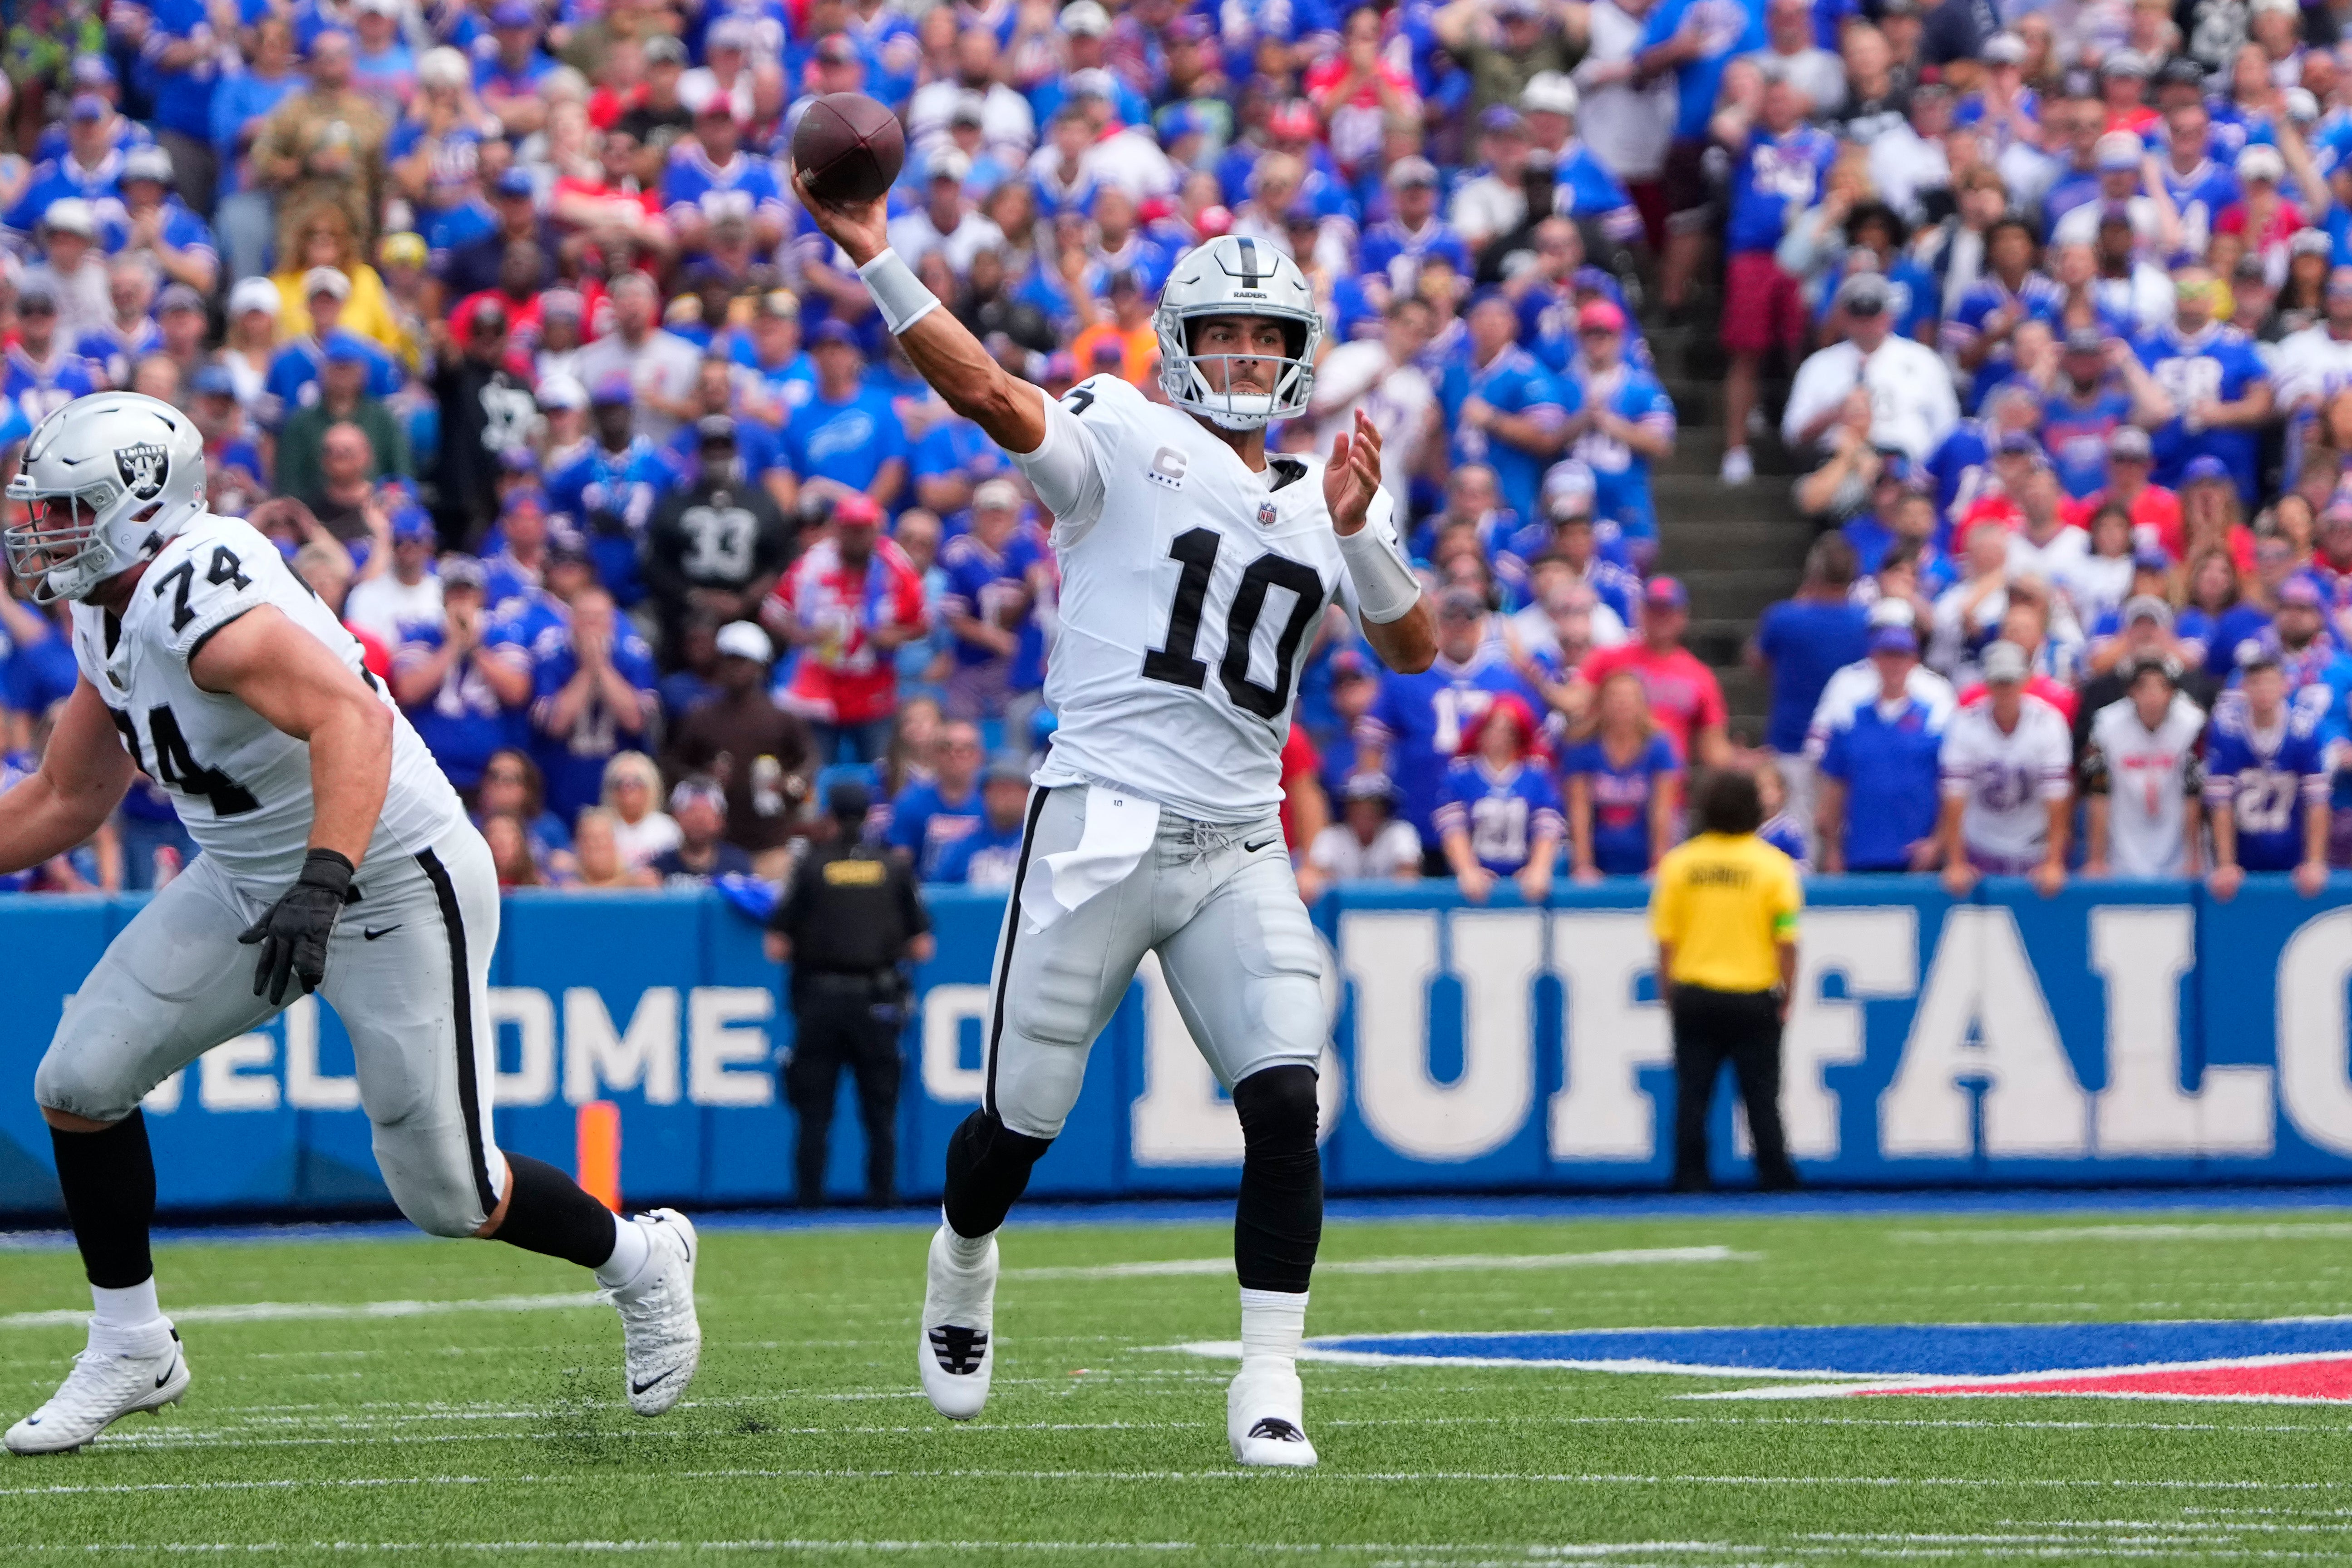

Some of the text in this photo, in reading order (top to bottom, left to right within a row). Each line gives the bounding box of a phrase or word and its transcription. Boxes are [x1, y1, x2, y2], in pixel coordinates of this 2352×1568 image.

[119, 445, 166, 457] RAIDERS
[1152, 446, 1187, 478] C
[153, 545, 253, 633] 74
[1139, 524, 1326, 721] 10
[63, 984, 775, 1115] ELOME
